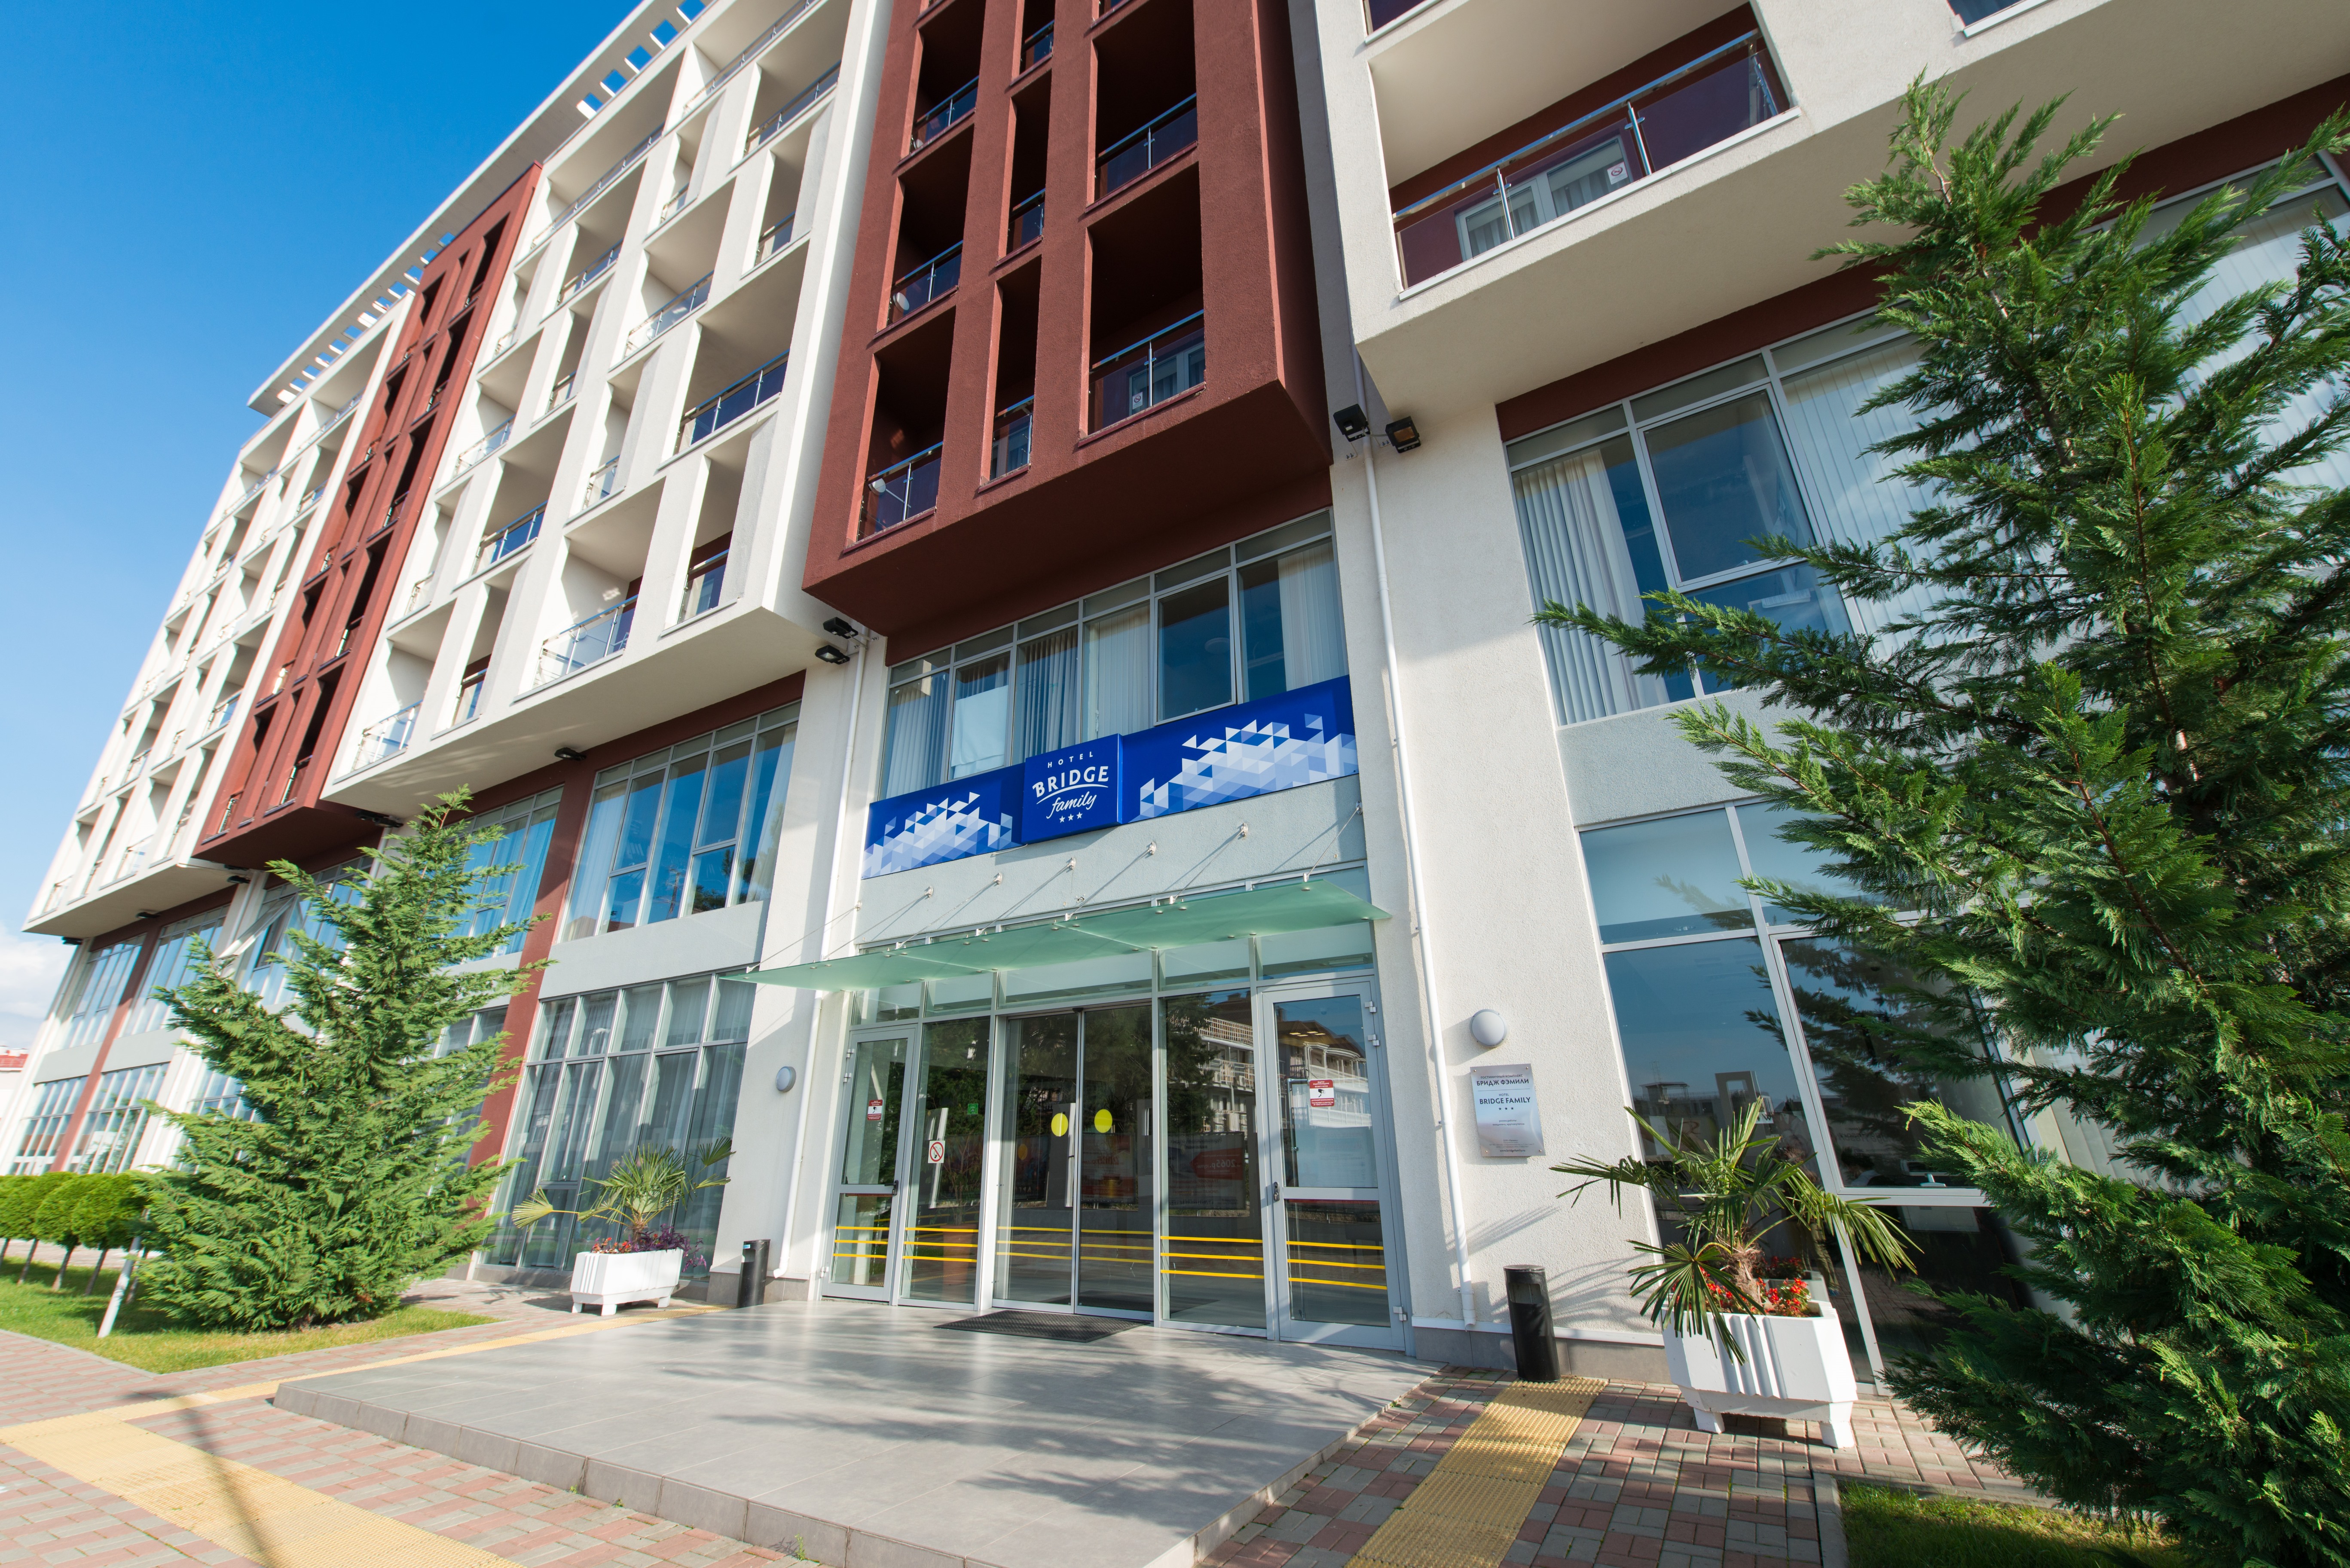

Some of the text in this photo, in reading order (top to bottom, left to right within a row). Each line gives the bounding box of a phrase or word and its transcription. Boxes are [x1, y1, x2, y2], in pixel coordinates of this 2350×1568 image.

[1047, 751, 1093, 768] HOTEL
[1032, 766, 1109, 798] BRIDGE
[1046, 791, 1097, 819] family
